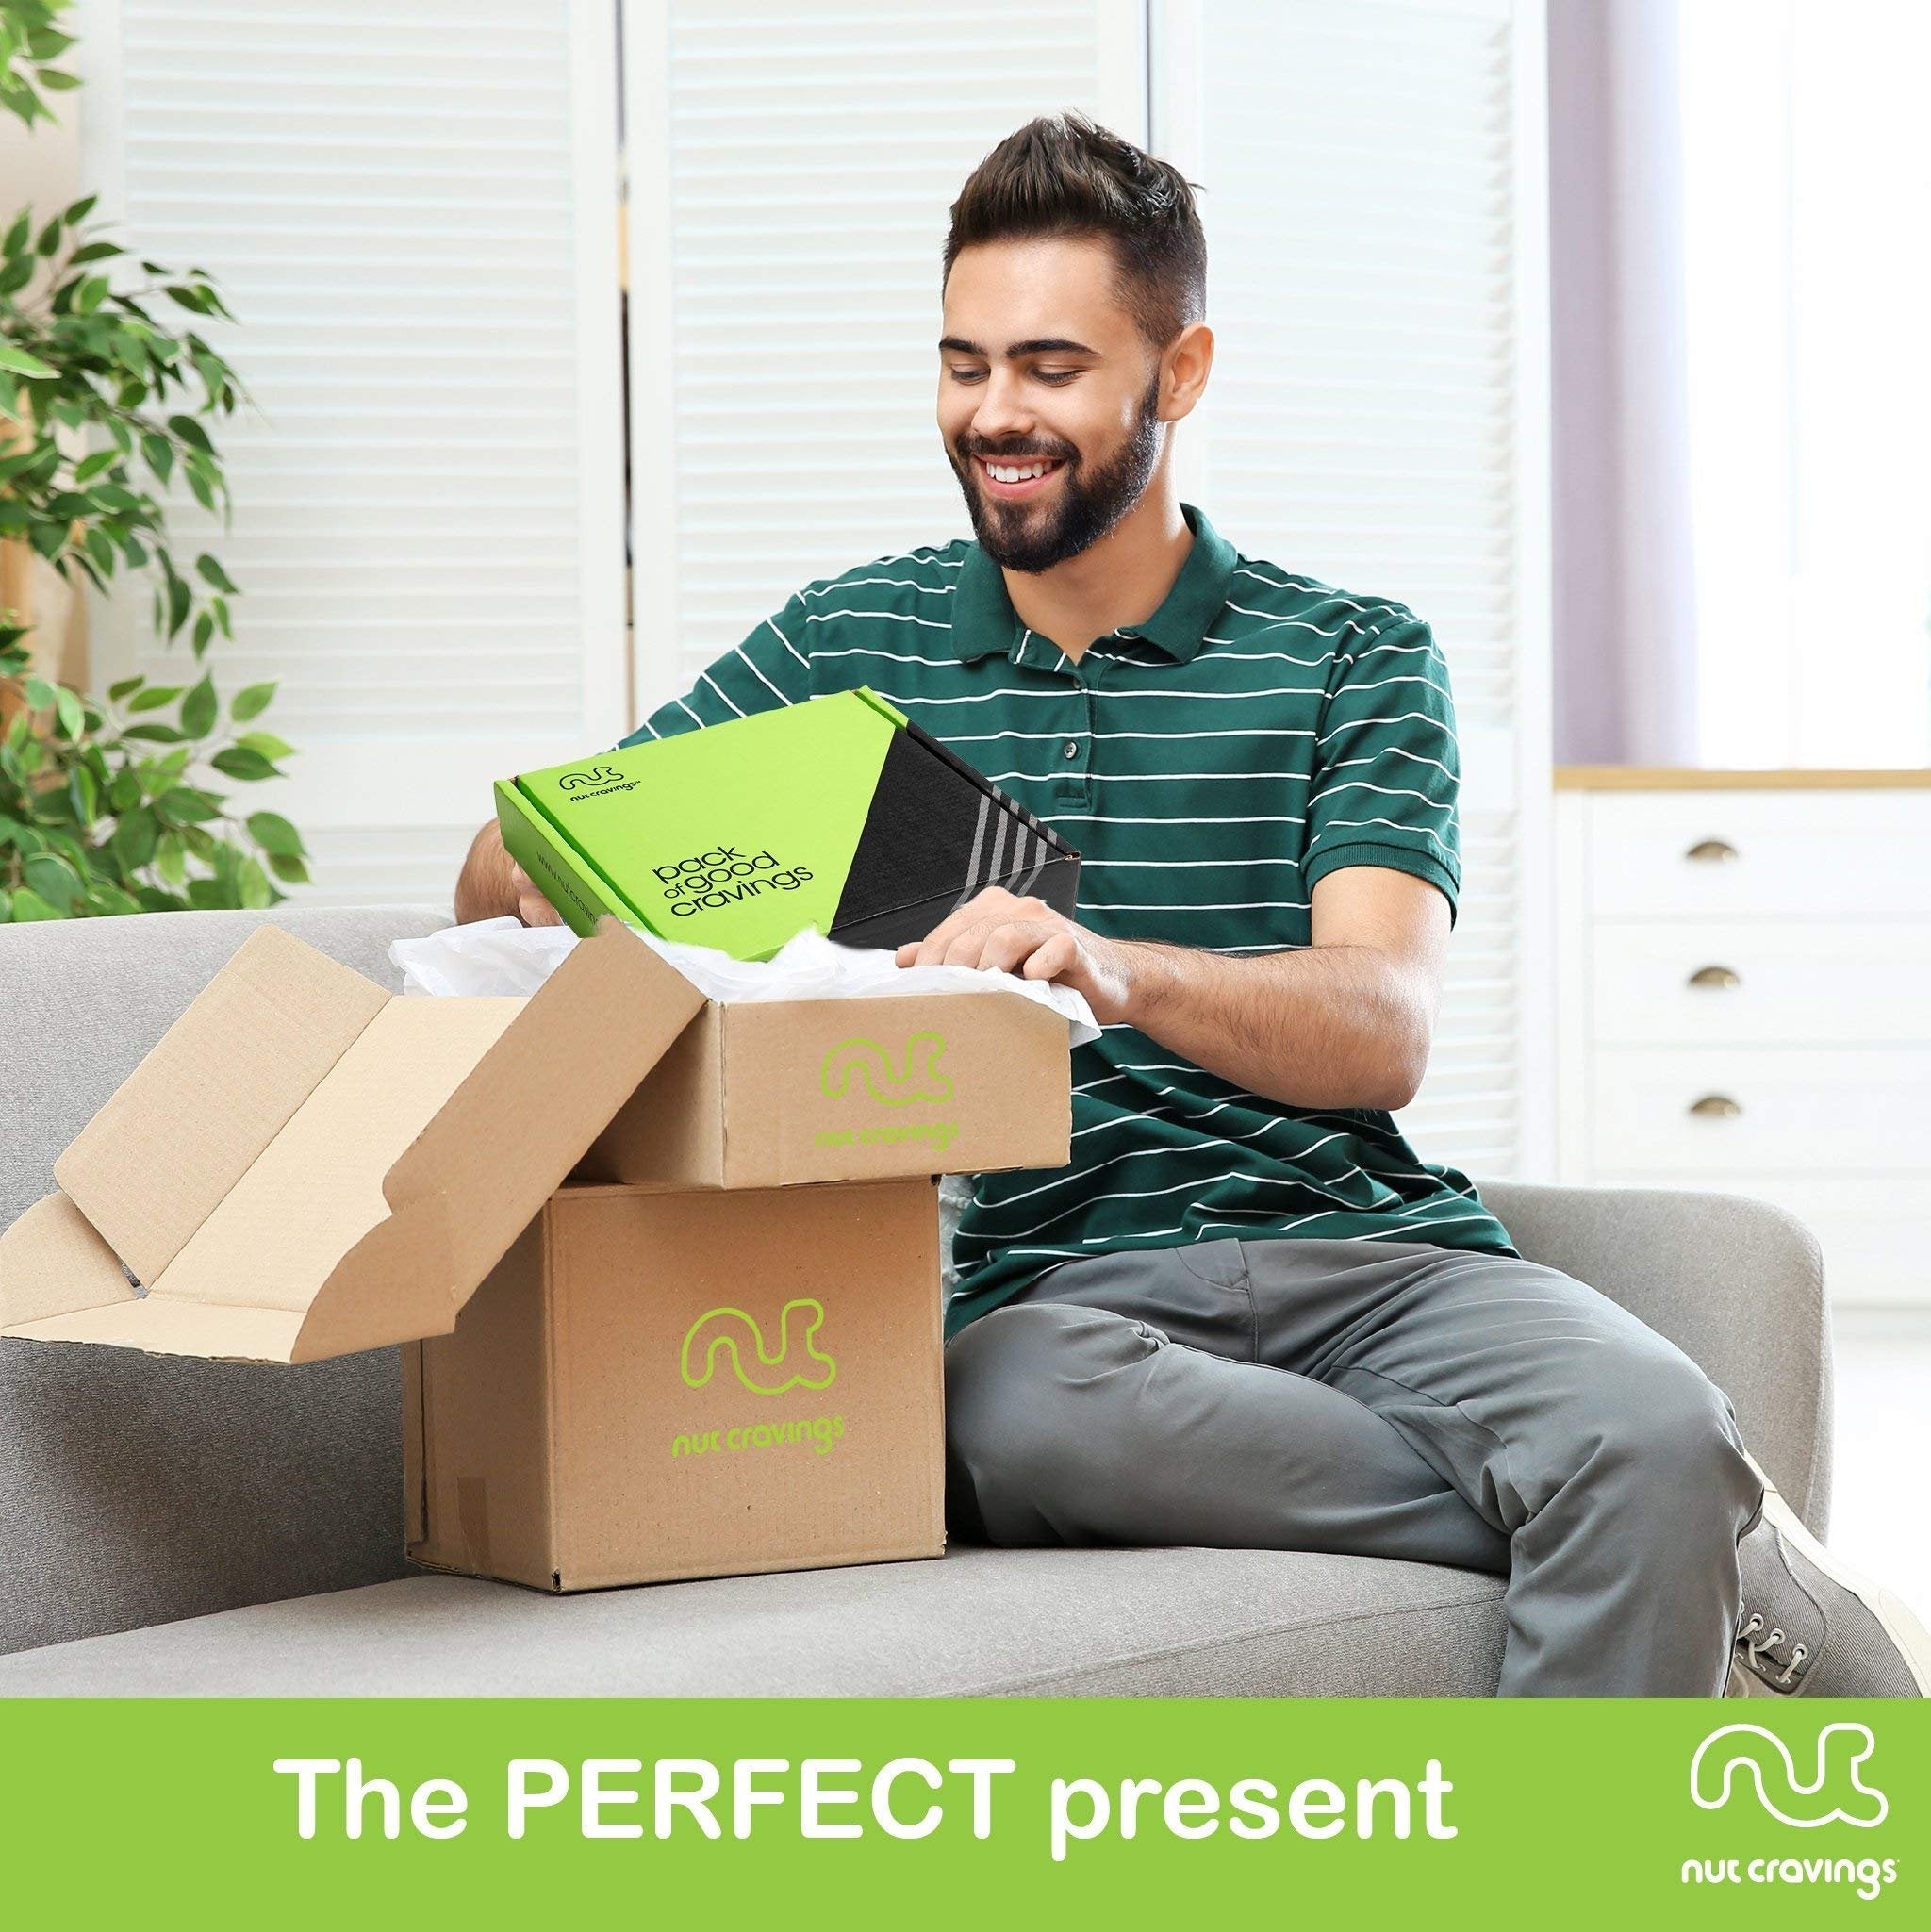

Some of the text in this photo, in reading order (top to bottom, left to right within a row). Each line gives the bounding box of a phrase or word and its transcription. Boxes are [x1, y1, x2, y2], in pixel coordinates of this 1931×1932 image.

[570, 793, 590, 801] nut
[652, 846, 746, 884] pack
[663, 850, 780, 899] of good
[670, 867, 814, 916] cravings
[671, 1415, 846, 1458] nut cravings
